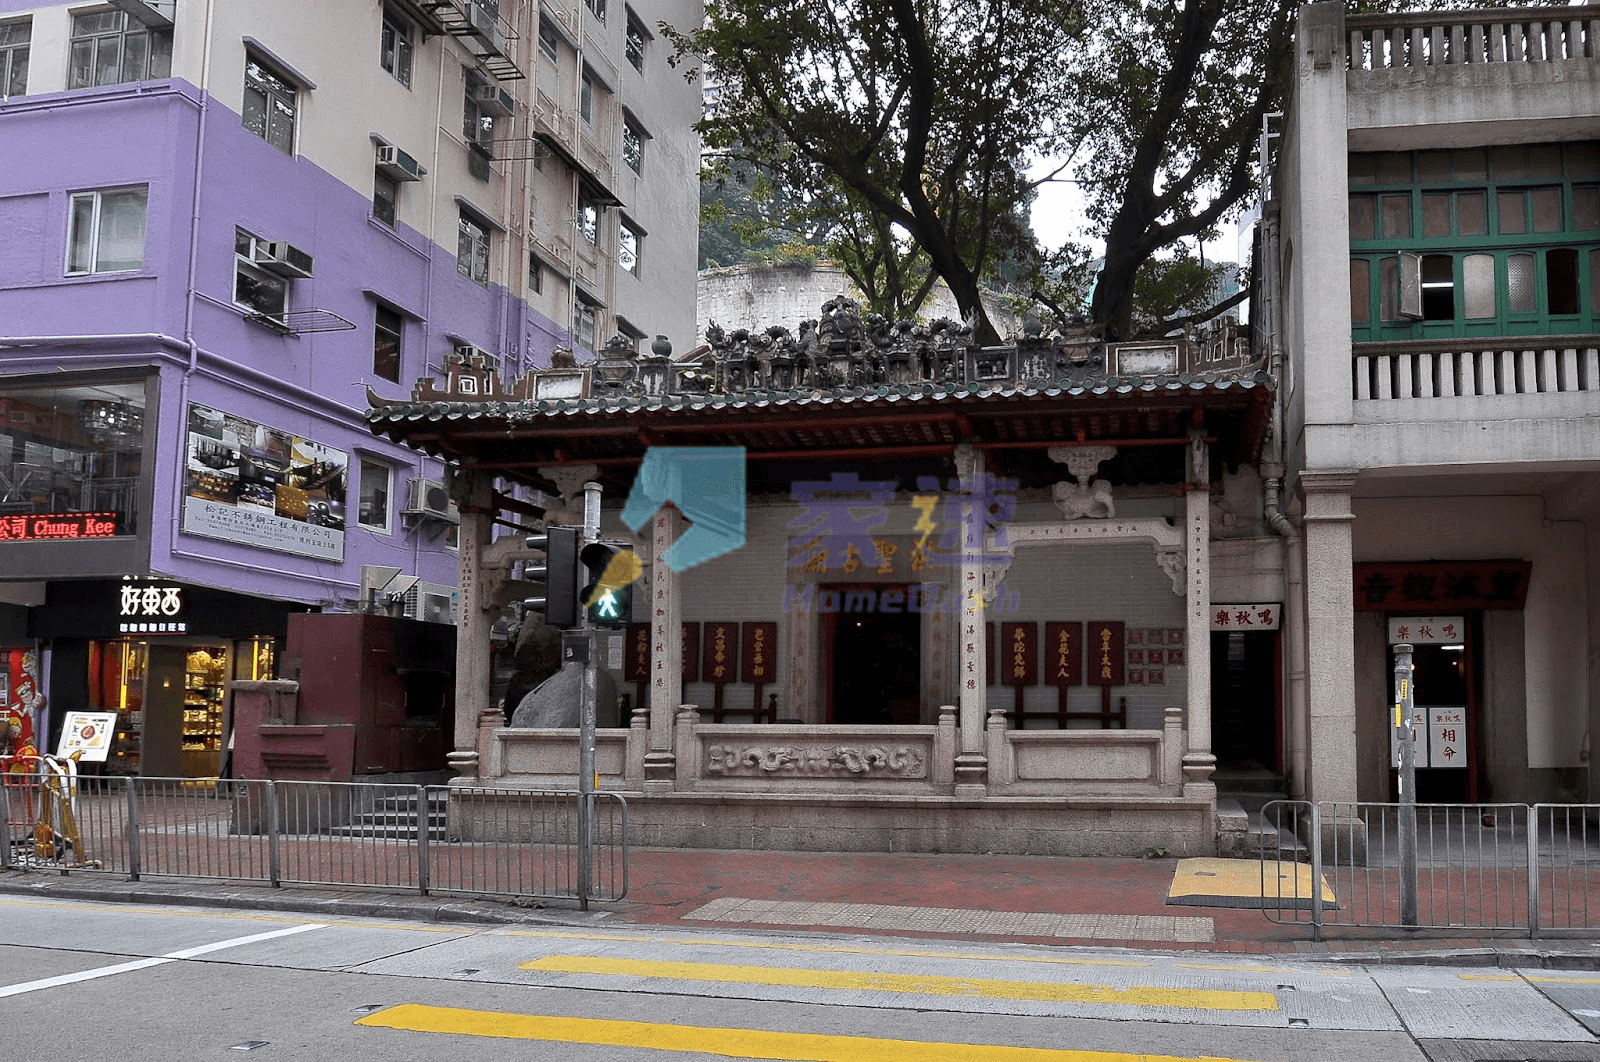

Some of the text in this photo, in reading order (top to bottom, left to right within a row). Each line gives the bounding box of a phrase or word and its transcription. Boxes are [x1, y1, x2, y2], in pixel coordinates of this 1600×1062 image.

[34, 519, 80, 538] Chung
[85, 518, 116, 534] Kee
[119, 585, 182, 616] 好東西
[1441, 728, 1457, 762] 相命
